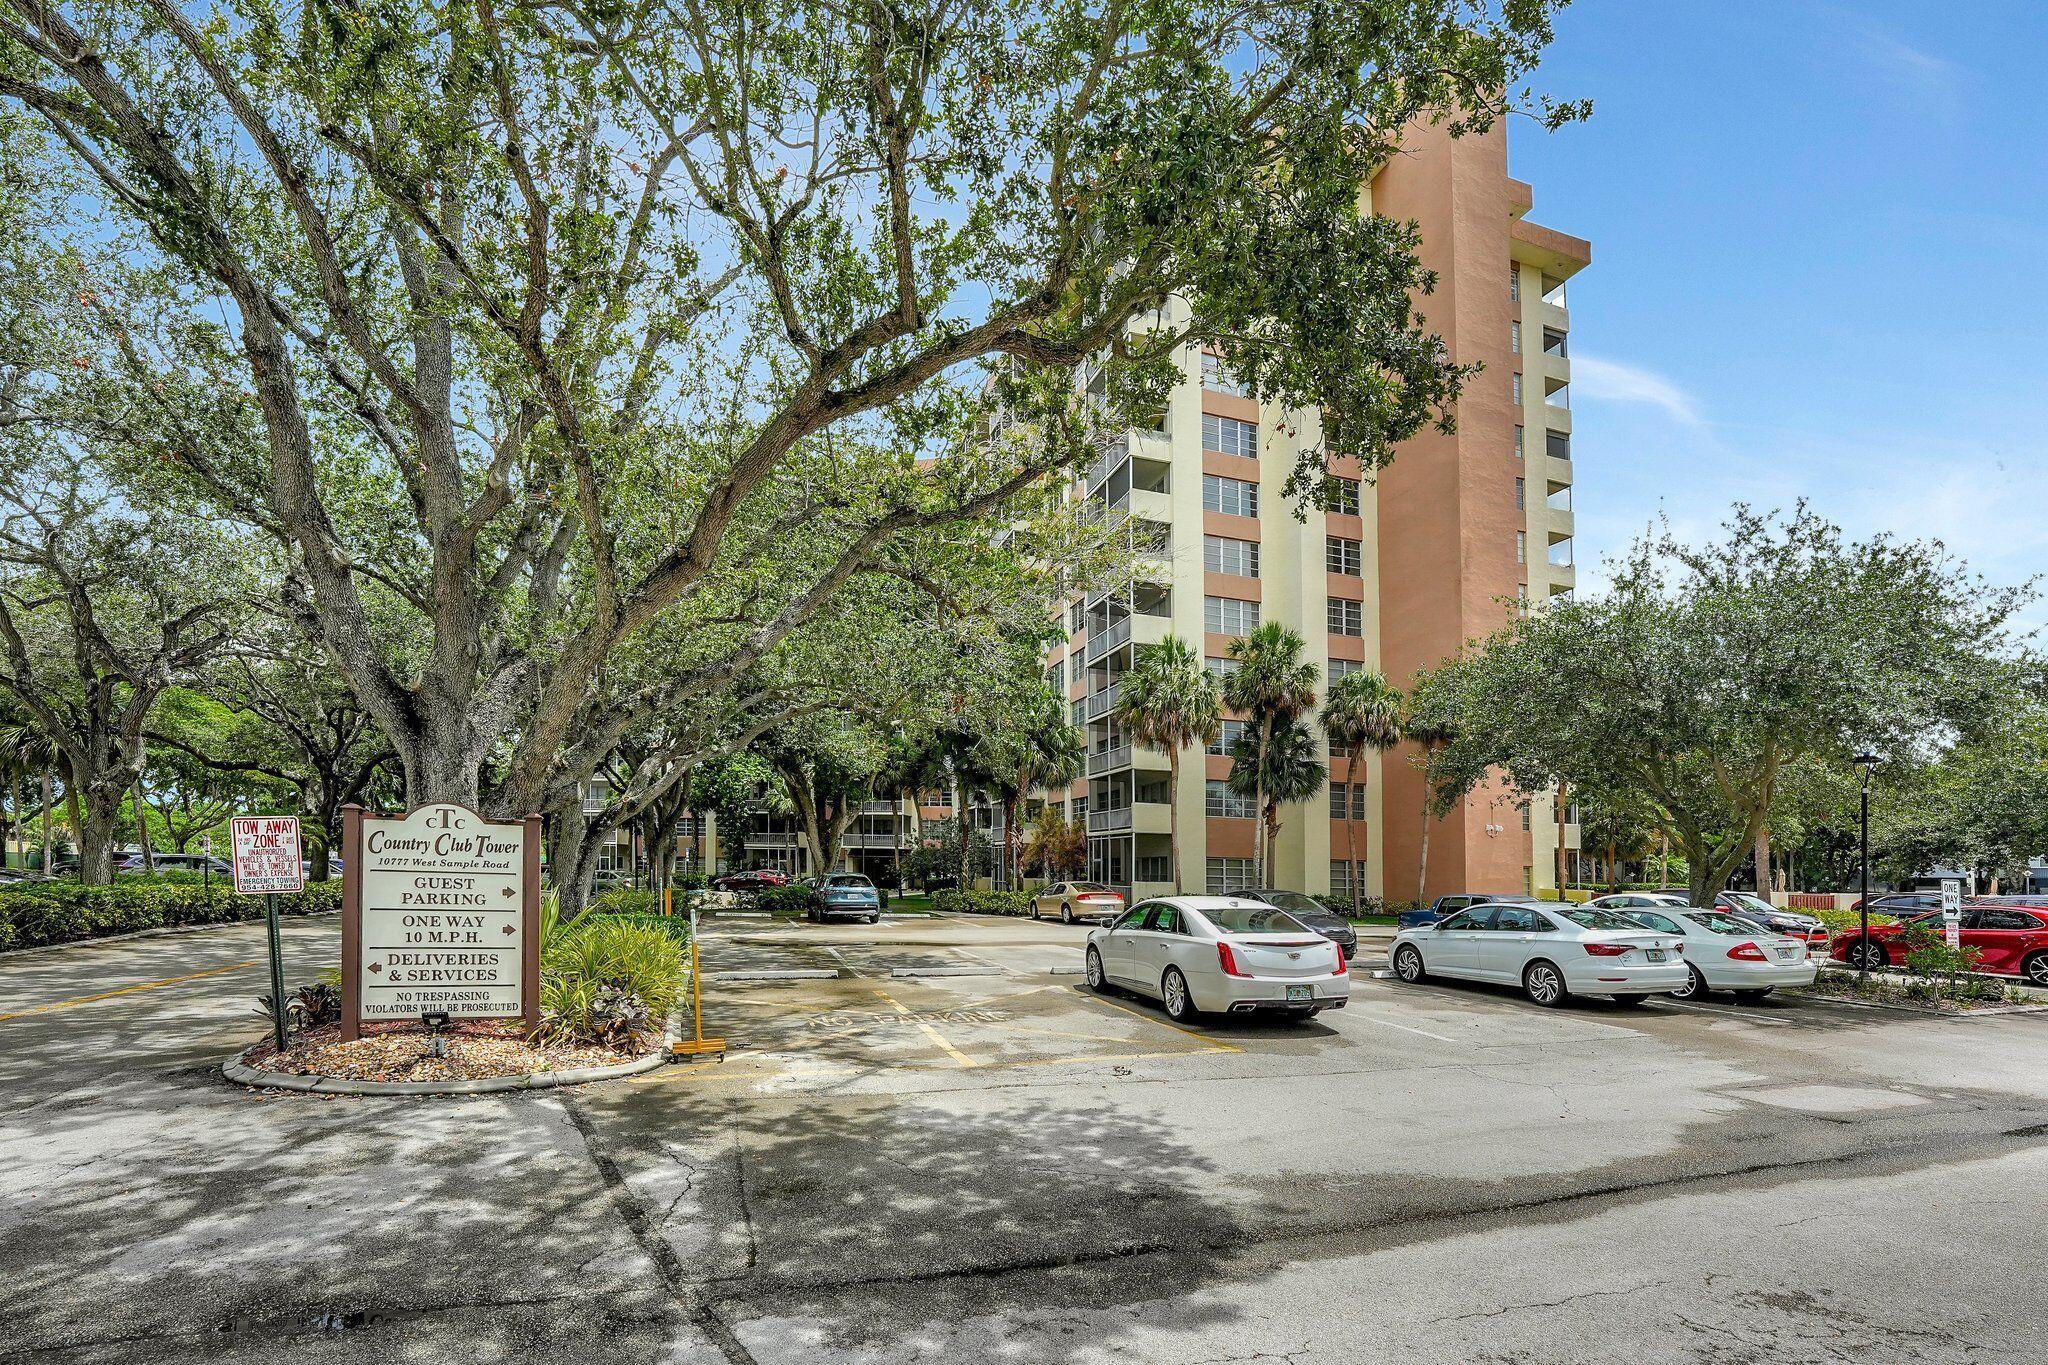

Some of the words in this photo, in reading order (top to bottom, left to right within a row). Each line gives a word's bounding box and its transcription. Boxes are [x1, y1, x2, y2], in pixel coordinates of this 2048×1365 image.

[236, 821, 258, 834] TOW
[266, 821, 294, 834] AWAY
[253, 835, 280, 848] ZONE
[367, 830, 431, 854] Country
[434, 833, 473, 856] Club
[475, 835, 519, 858] Tower
[377, 857, 409, 866] 10777
[412, 858, 436, 867] West
[439, 859, 480, 869] Sample
[483, 860, 510, 869] Road
[414, 877, 475, 890] GUEST
[1944, 884, 1957, 893] ONE
[401, 892, 487, 905] PARKING
[1945, 895, 1958, 904] WAY
[402, 915, 441, 927] ONE
[445, 915, 485, 927] WAY
[405, 931, 422, 943] 10
[428, 931, 483, 943] M.P.H.
[387, 953, 499, 966] DELIVERIES
[388, 969, 402, 982] &
[407, 969, 498, 982] SERVICES
[396, 992, 412, 1001] NO
[415, 991, 490, 1001] TRESPASSING
[365, 1004, 418, 1013] VIOLATORS
[420, 1003, 445, 1013] WILL
[447, 1003, 459, 1012] BE
[461, 1002, 519, 1012] PROSECUTED
